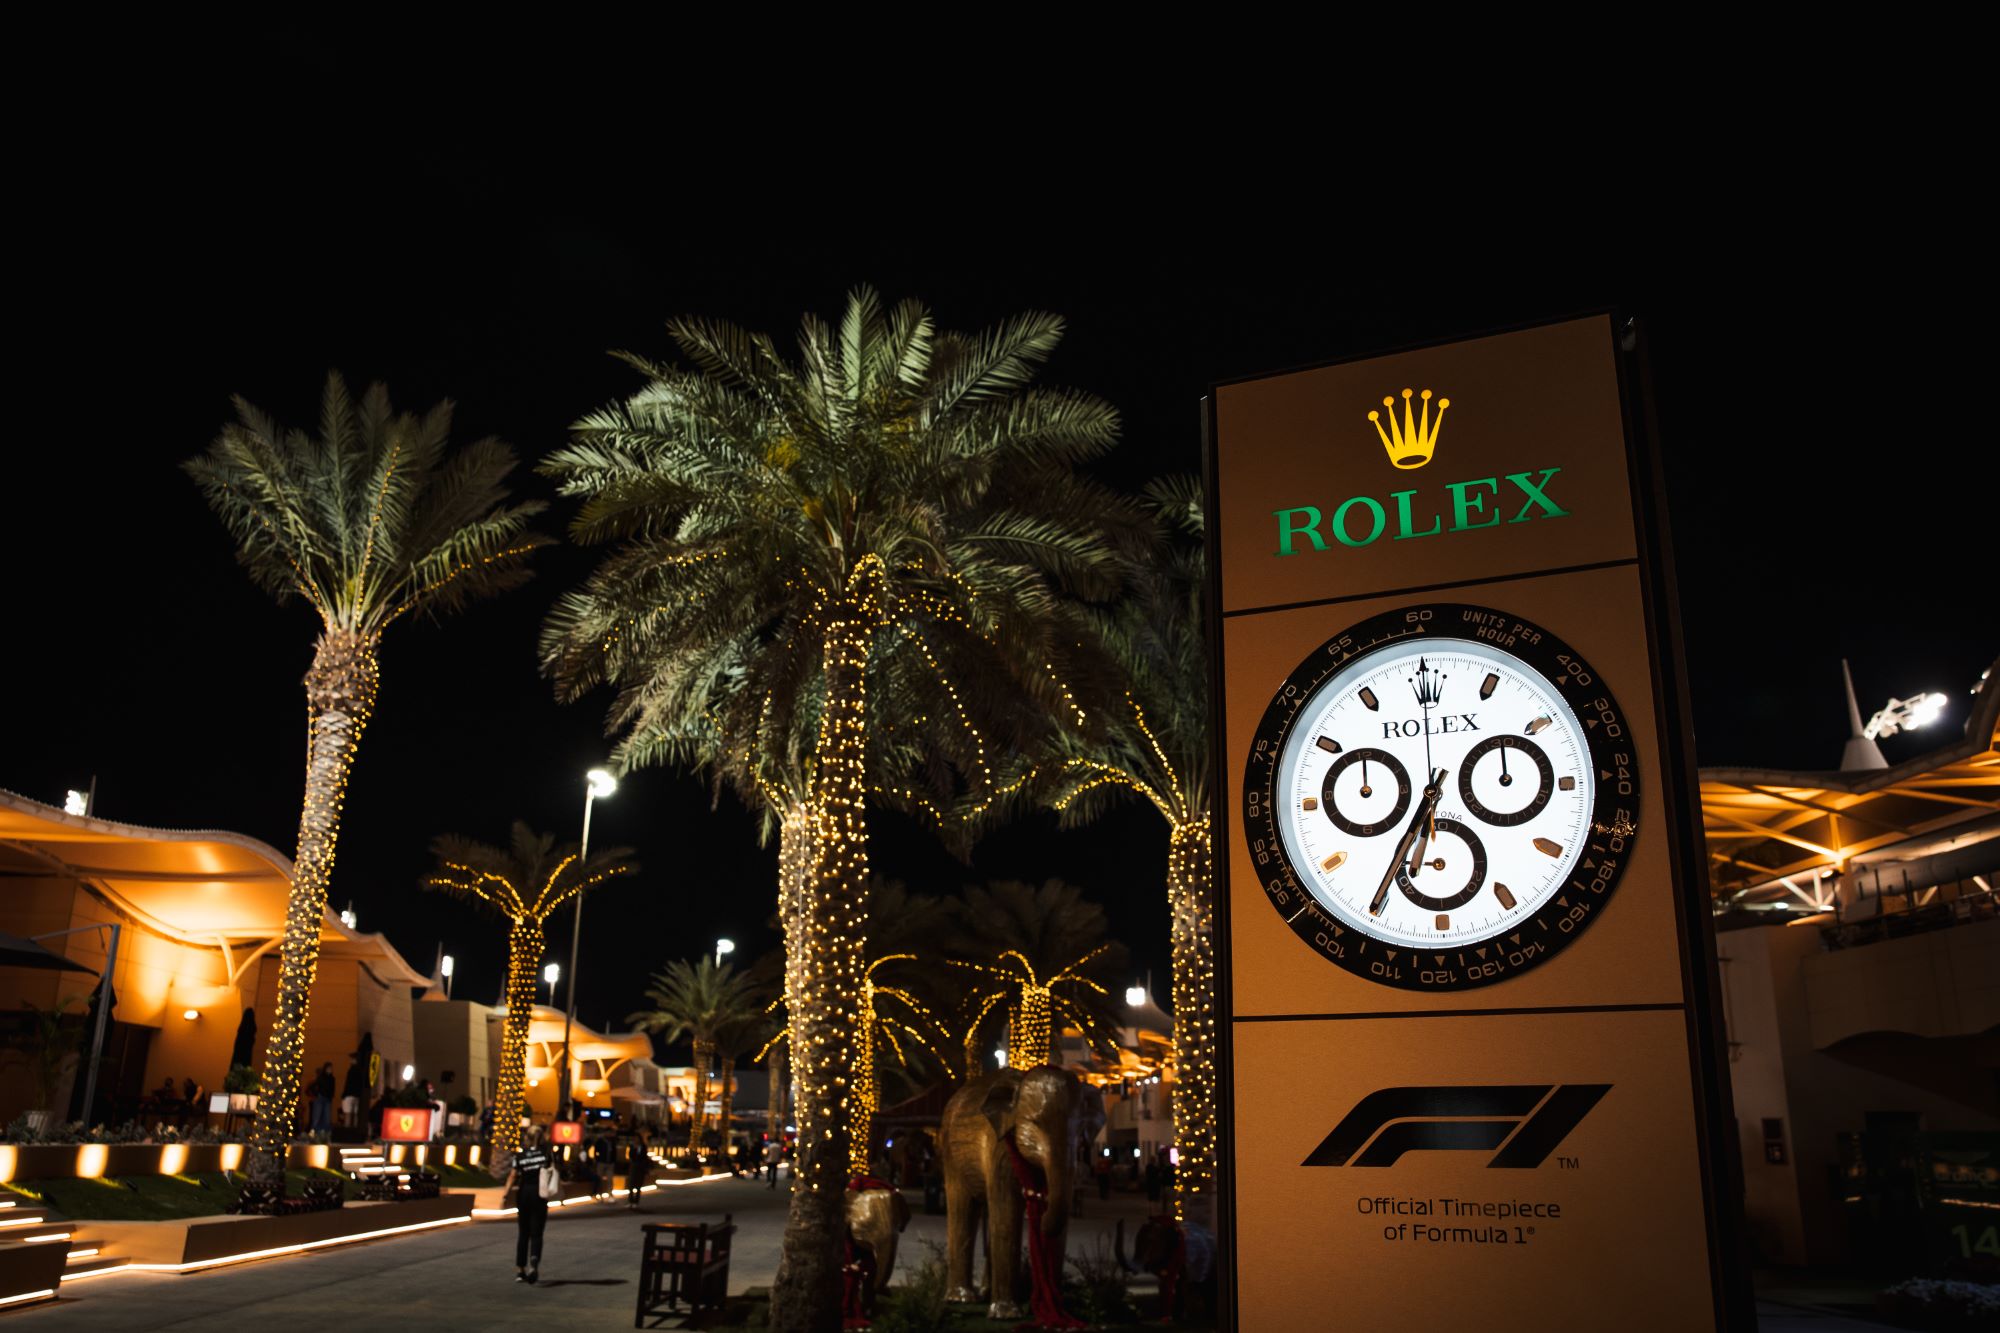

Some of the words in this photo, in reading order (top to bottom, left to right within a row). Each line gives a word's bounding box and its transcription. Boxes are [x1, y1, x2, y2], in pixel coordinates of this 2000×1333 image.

[1272, 468, 1570, 557] ROLEX
[1405, 610, 1432, 622] 60
[1462, 609, 1506, 629] UNITS
[1512, 623, 1543, 645] PER
[1327, 634, 1352, 655] 65
[1476, 625, 1516, 648] HOUR
[1555, 653, 1592, 687] 400
[1276, 684, 1297, 707] 70
[1382, 713, 1481, 739] ROLEX
[1594, 697, 1621, 737] 300
[1252, 739, 1268, 764] 75
[1614, 752, 1632, 795] 240
[1248, 791, 1260, 818] 80
[1609, 807, 1630, 854] 200
[1253, 838, 1270, 865] 85
[1590, 859, 1617, 895] 180
[1268, 879, 1290, 906] 90
[1558, 901, 1593, 933] 160
[1315, 931, 1345, 959] 100
[1508, 941, 1545, 967] 140
[1371, 961, 1402, 980] 110
[1420, 970, 1457, 983] 120
[1467, 960, 1505, 980] 130
[1300, 1084, 1614, 1168] F1
[1557, 1157, 1580, 1169] TM
[1357, 1197, 1434, 1216] Official
[1439, 1198, 1561, 1220] Timepiece
[1384, 1224, 1407, 1241] of
[1413, 1224, 1508, 1244] Formula
